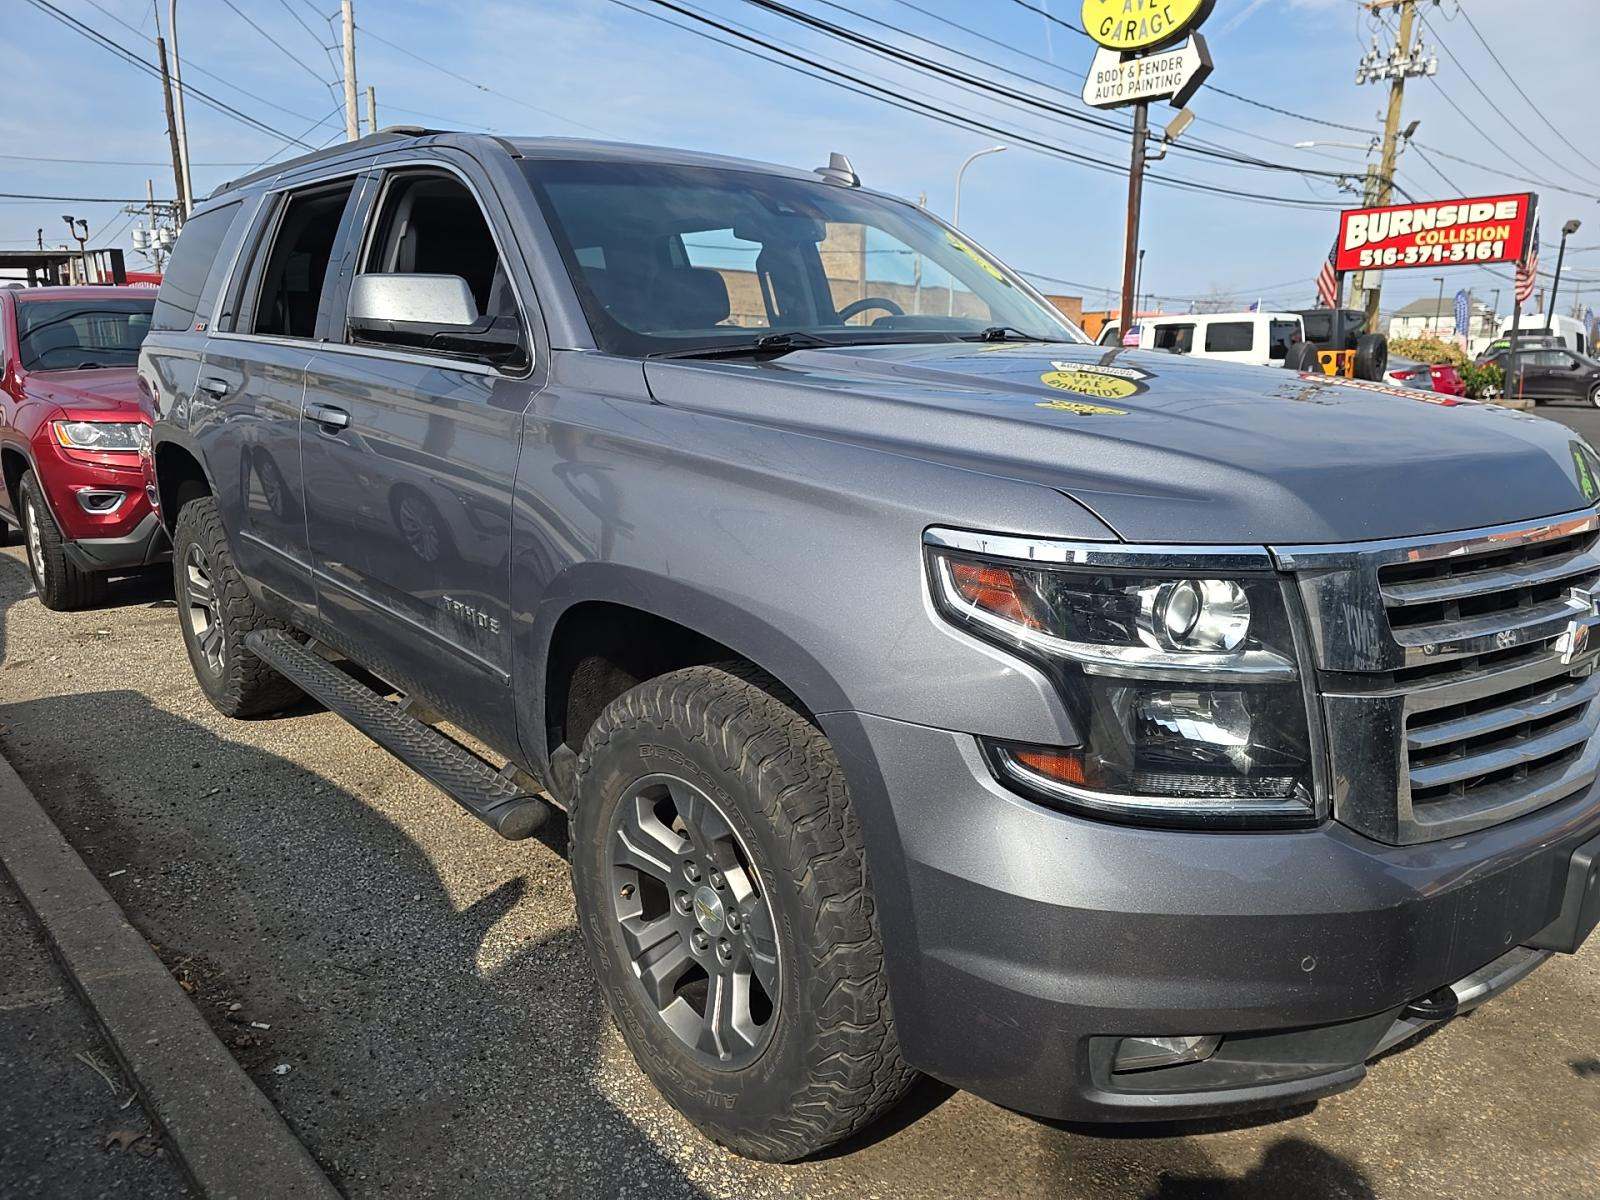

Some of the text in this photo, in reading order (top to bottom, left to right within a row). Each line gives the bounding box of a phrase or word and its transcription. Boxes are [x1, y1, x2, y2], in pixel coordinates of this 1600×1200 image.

[1100, 5, 1175, 41] GARAGE
[1097, 56, 1183, 84] BODY & FENDER
[1095, 73, 1182, 99] AUTO PAINTING
[1345, 200, 1518, 250] BURNSIDE
[1415, 225, 1511, 246] COLLISION
[1359, 240, 1504, 267] 516-371-3161
